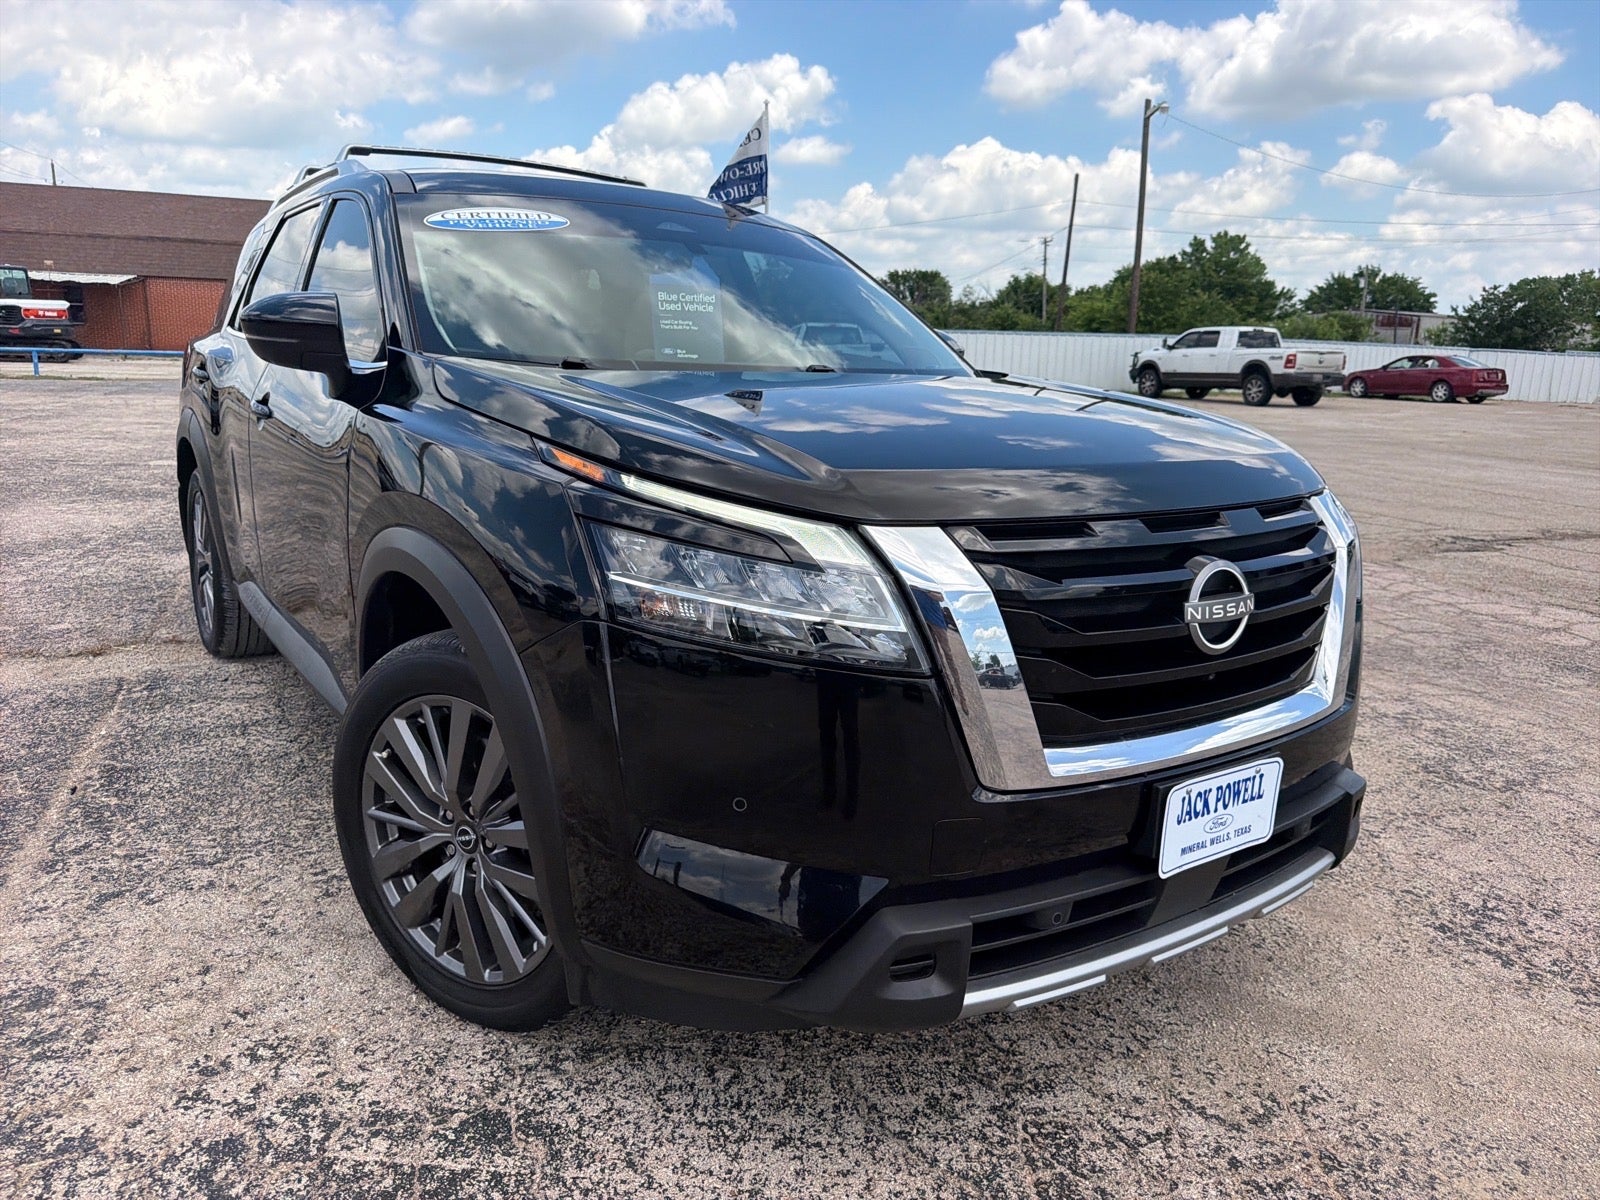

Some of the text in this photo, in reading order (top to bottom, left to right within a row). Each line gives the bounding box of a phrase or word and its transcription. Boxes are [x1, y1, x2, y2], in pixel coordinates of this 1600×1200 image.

[441, 211, 552, 220] CERTIFIED
[657, 291, 716, 303] Blue Certified
[658, 301, 714, 312] Used Vehicle
[1187, 597, 1255, 620] NISSAN
[1176, 773, 1265, 826] JACK POWELL
[1208, 816, 1229, 832] Ford
[1180, 824, 1253, 857] MINERAL WELLS, TEXAS
